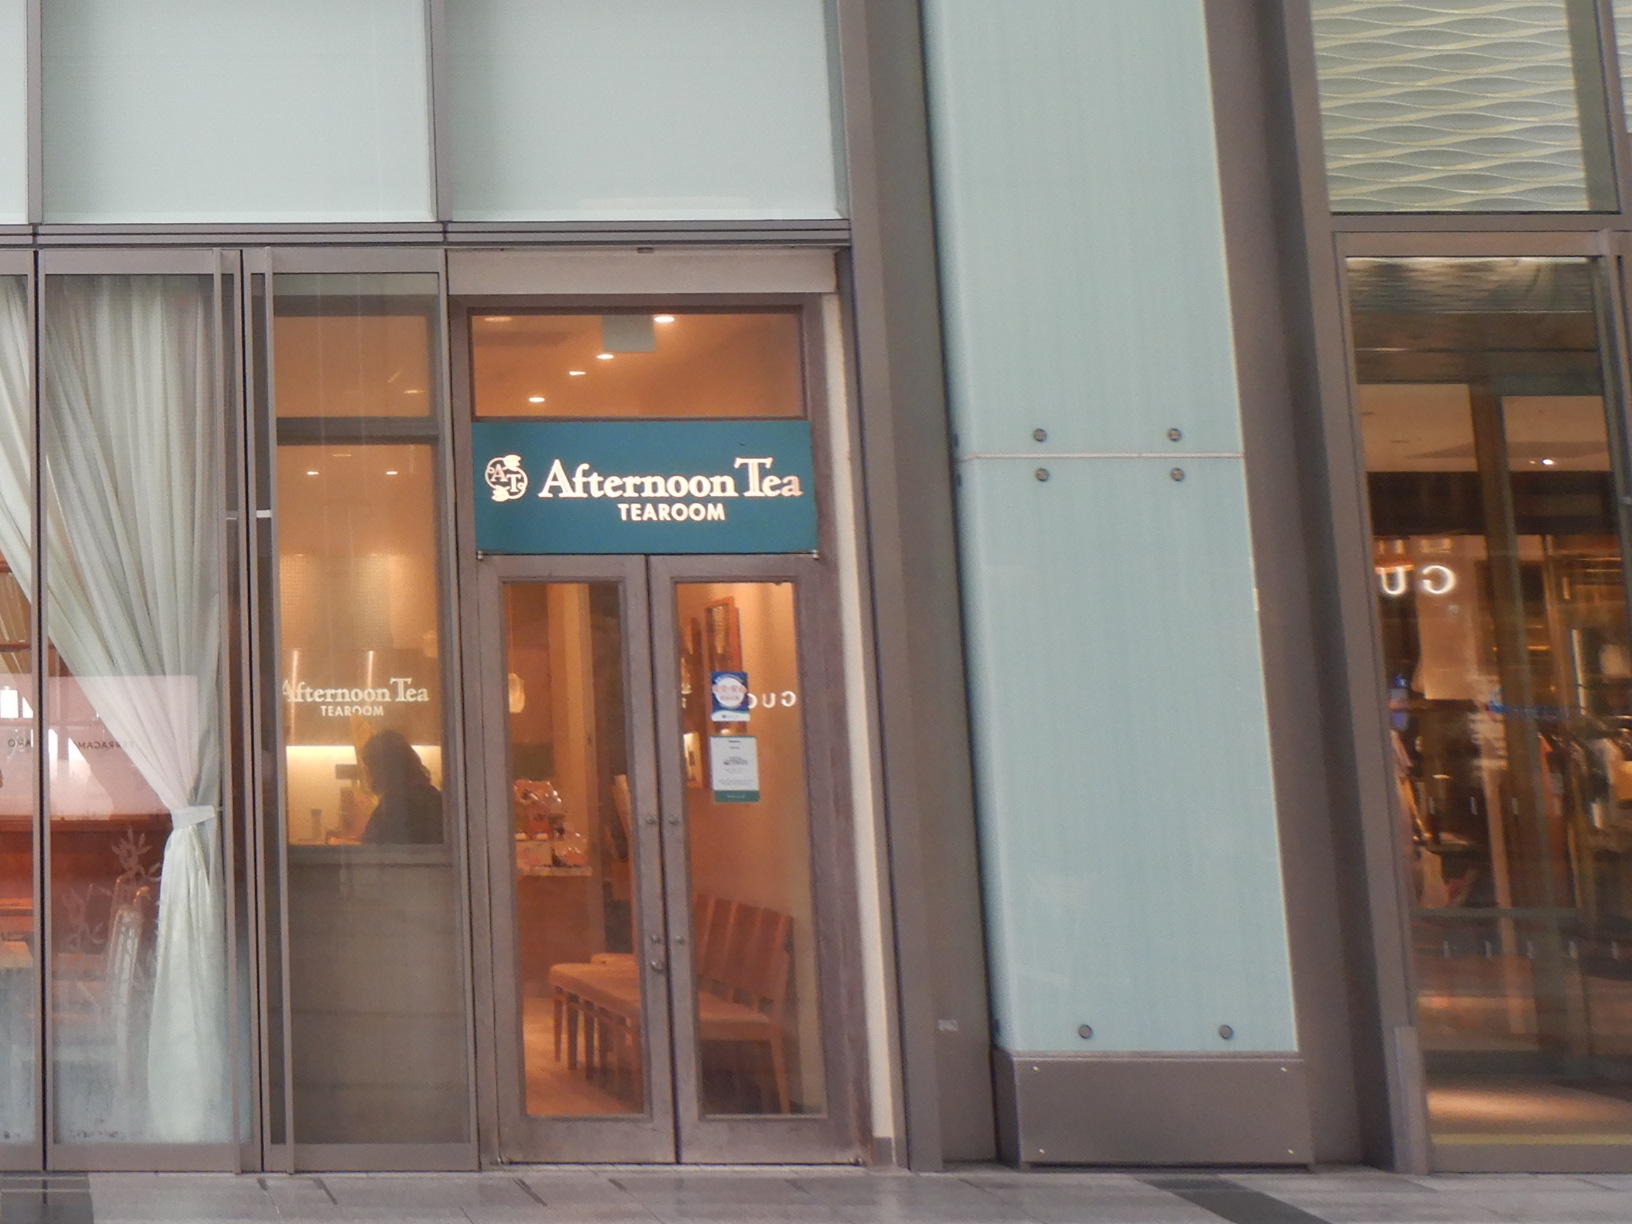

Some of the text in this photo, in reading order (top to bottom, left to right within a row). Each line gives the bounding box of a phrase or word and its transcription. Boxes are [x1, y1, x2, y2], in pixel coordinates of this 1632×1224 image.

[538, 456, 804, 499] Afternoon Tea
[618, 502, 726, 522] TEAROOM
[389, 677, 430, 702] Tea
[320, 705, 384, 717] TEAROOM
